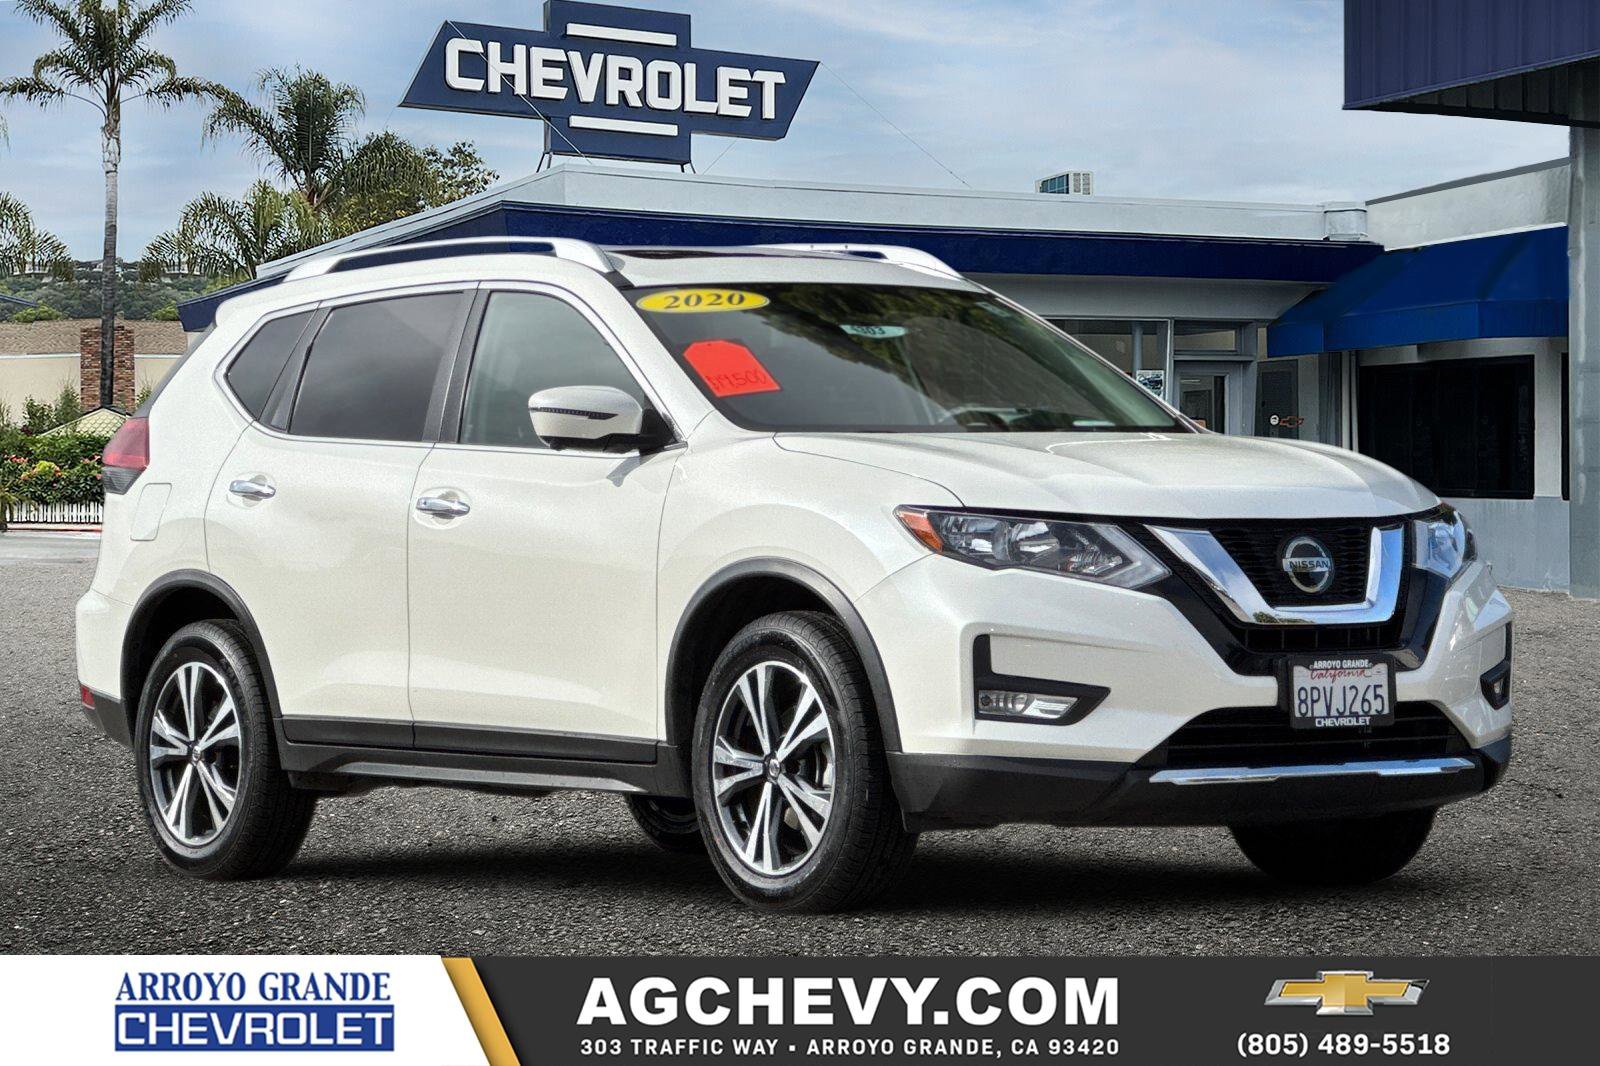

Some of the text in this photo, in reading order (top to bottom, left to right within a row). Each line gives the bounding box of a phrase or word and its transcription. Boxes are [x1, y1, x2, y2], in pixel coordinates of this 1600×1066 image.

[445, 37, 787, 120] CHEVROLET
[664, 291, 745, 309] 2020
[1289, 559, 1329, 569] NISSAN
[1313, 659, 1369, 669] ARROYO GRANDE
[1297, 684, 1385, 717] 8PVJ265
[1315, 716, 1371, 727] CHEVROLET
